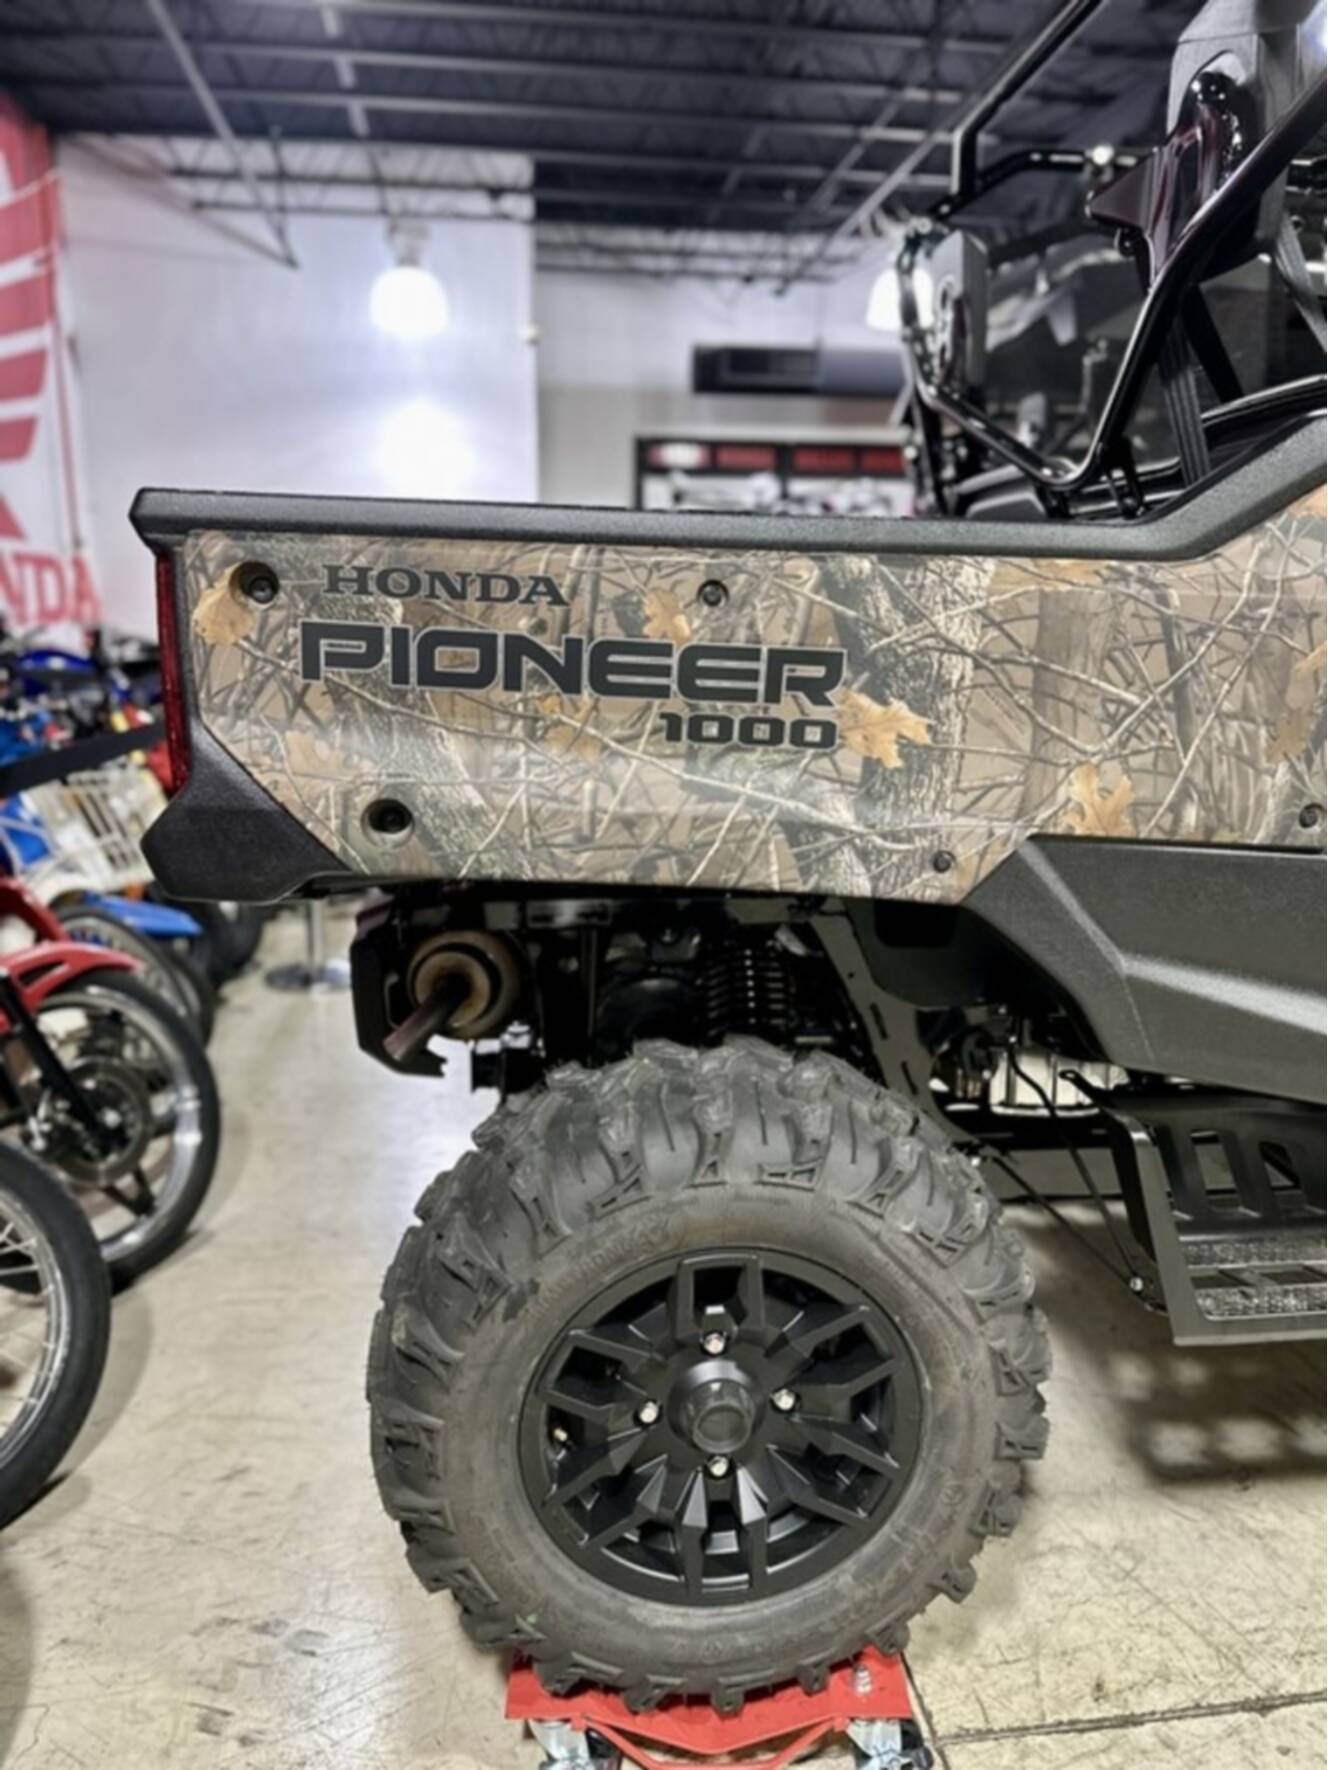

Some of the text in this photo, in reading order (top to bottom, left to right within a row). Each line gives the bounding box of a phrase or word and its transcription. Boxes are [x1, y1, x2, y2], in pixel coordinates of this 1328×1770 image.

[322, 564, 571, 607] HONDA
[301, 620, 847, 707] PIONEER
[658, 711, 838, 749] 1000
